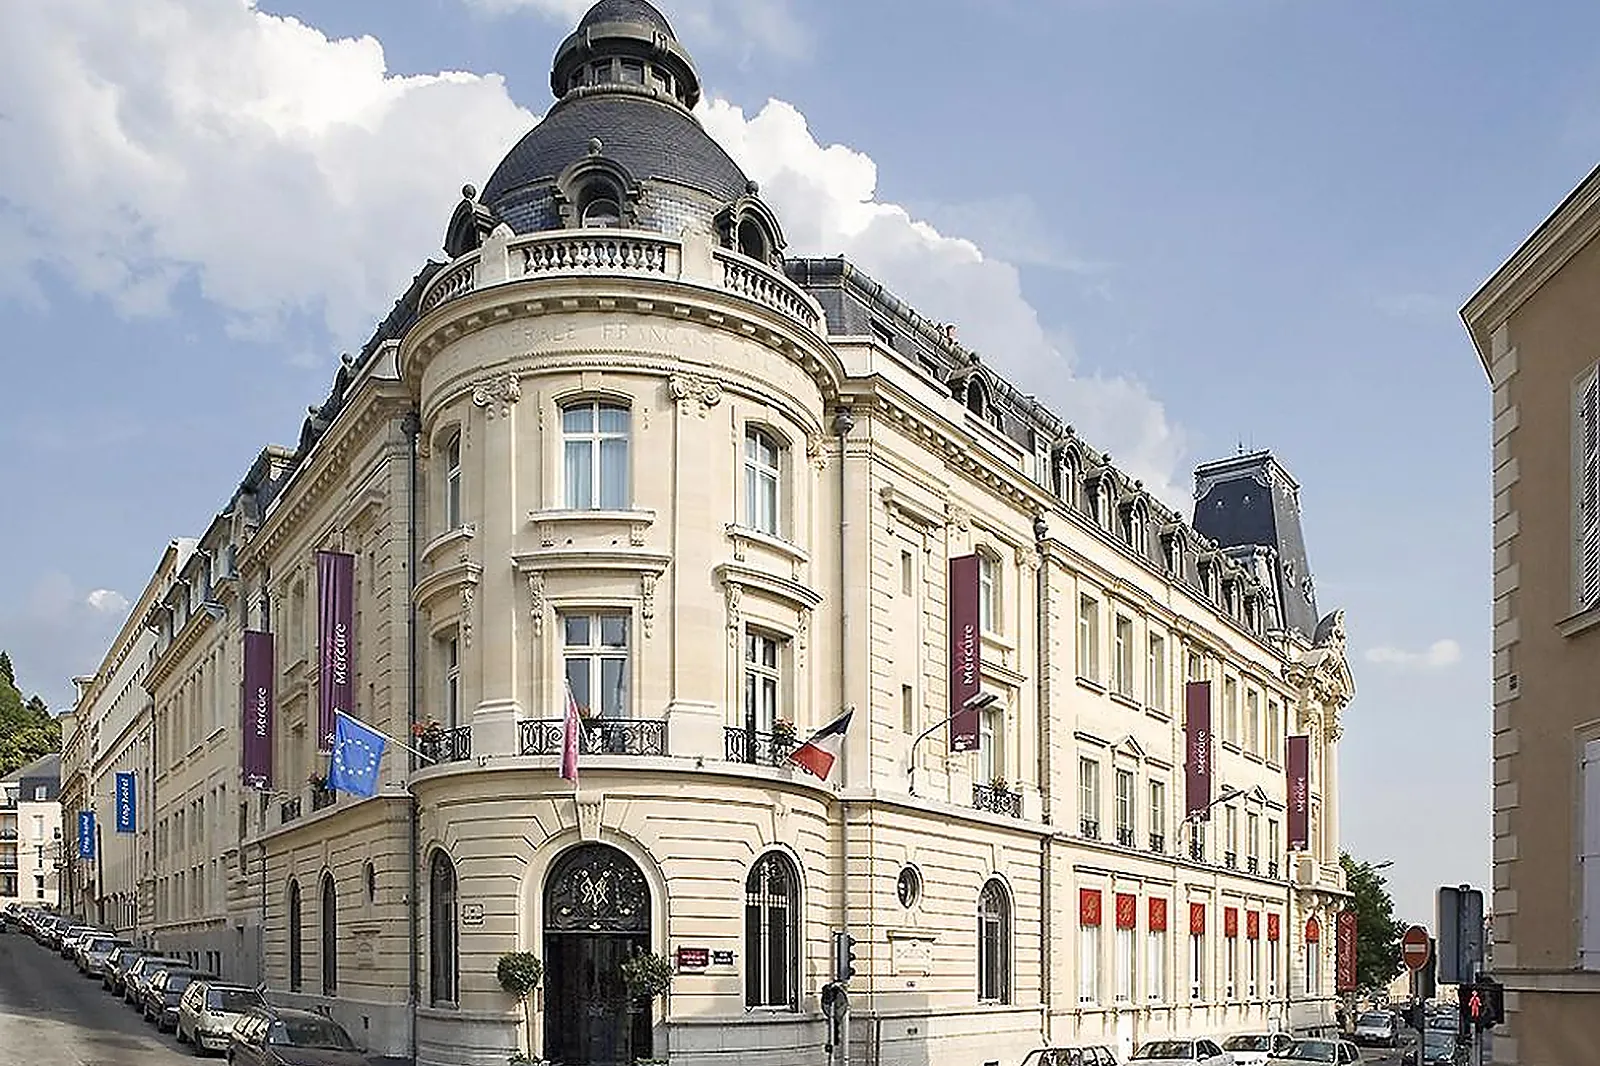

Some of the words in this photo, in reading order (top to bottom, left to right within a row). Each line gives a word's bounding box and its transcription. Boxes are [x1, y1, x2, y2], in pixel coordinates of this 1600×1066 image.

[334, 623, 347, 685] Mercure
[963, 624, 974, 686] Mercure
[256, 687, 267, 736] Mercure
